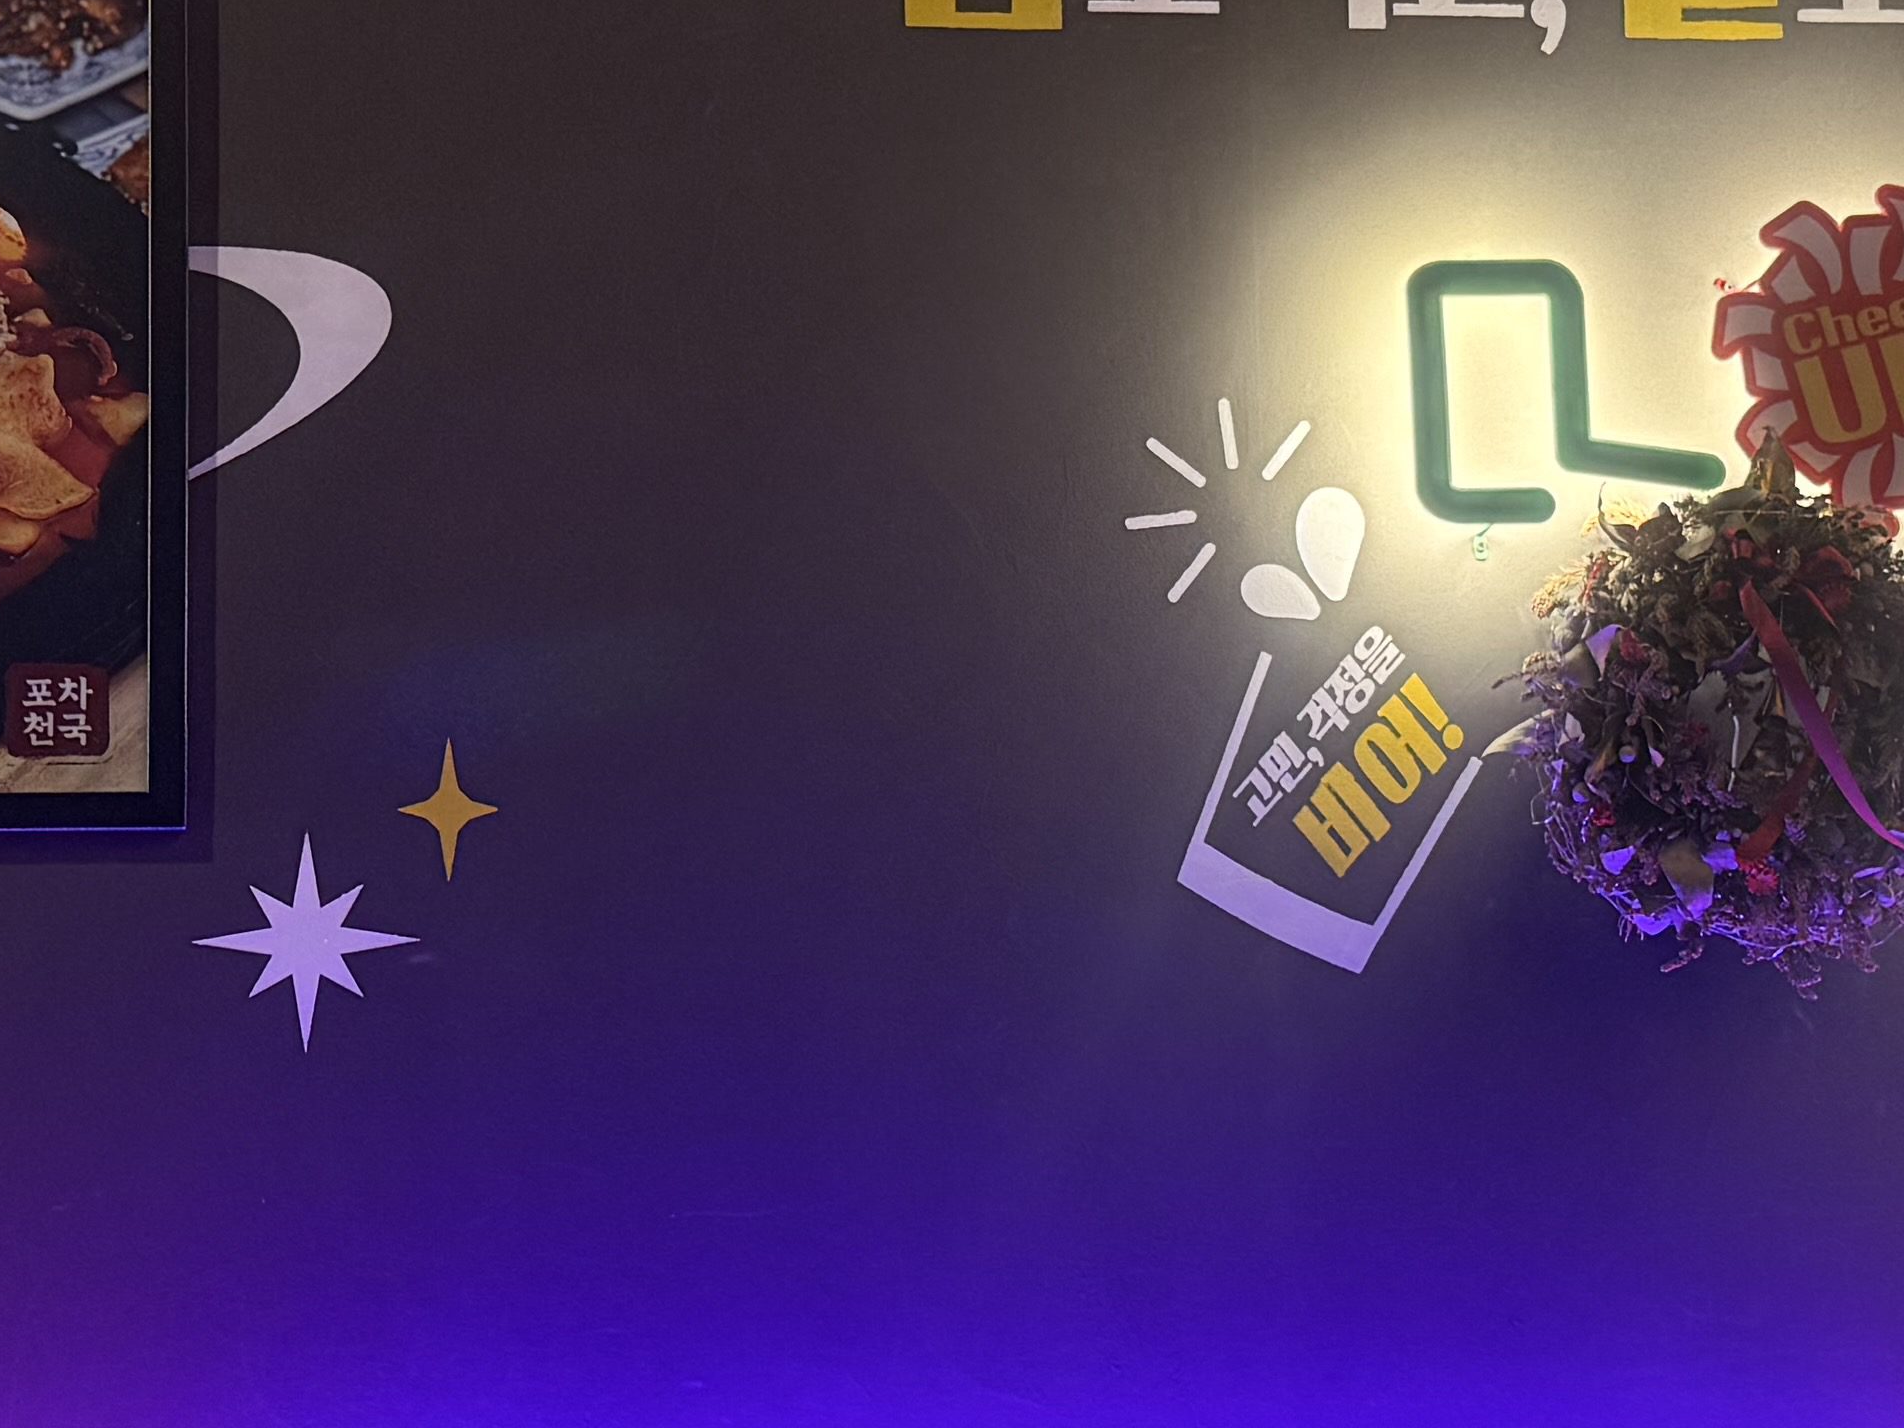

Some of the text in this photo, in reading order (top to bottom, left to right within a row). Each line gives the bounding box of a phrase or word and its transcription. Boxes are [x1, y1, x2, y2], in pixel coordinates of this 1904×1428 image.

[22, 676, 94, 710] 포차
[22, 712, 93, 746] 천국
[1232, 625, 1406, 827] 고민, 걱정을
[1292, 672, 1464, 878] 비어!
